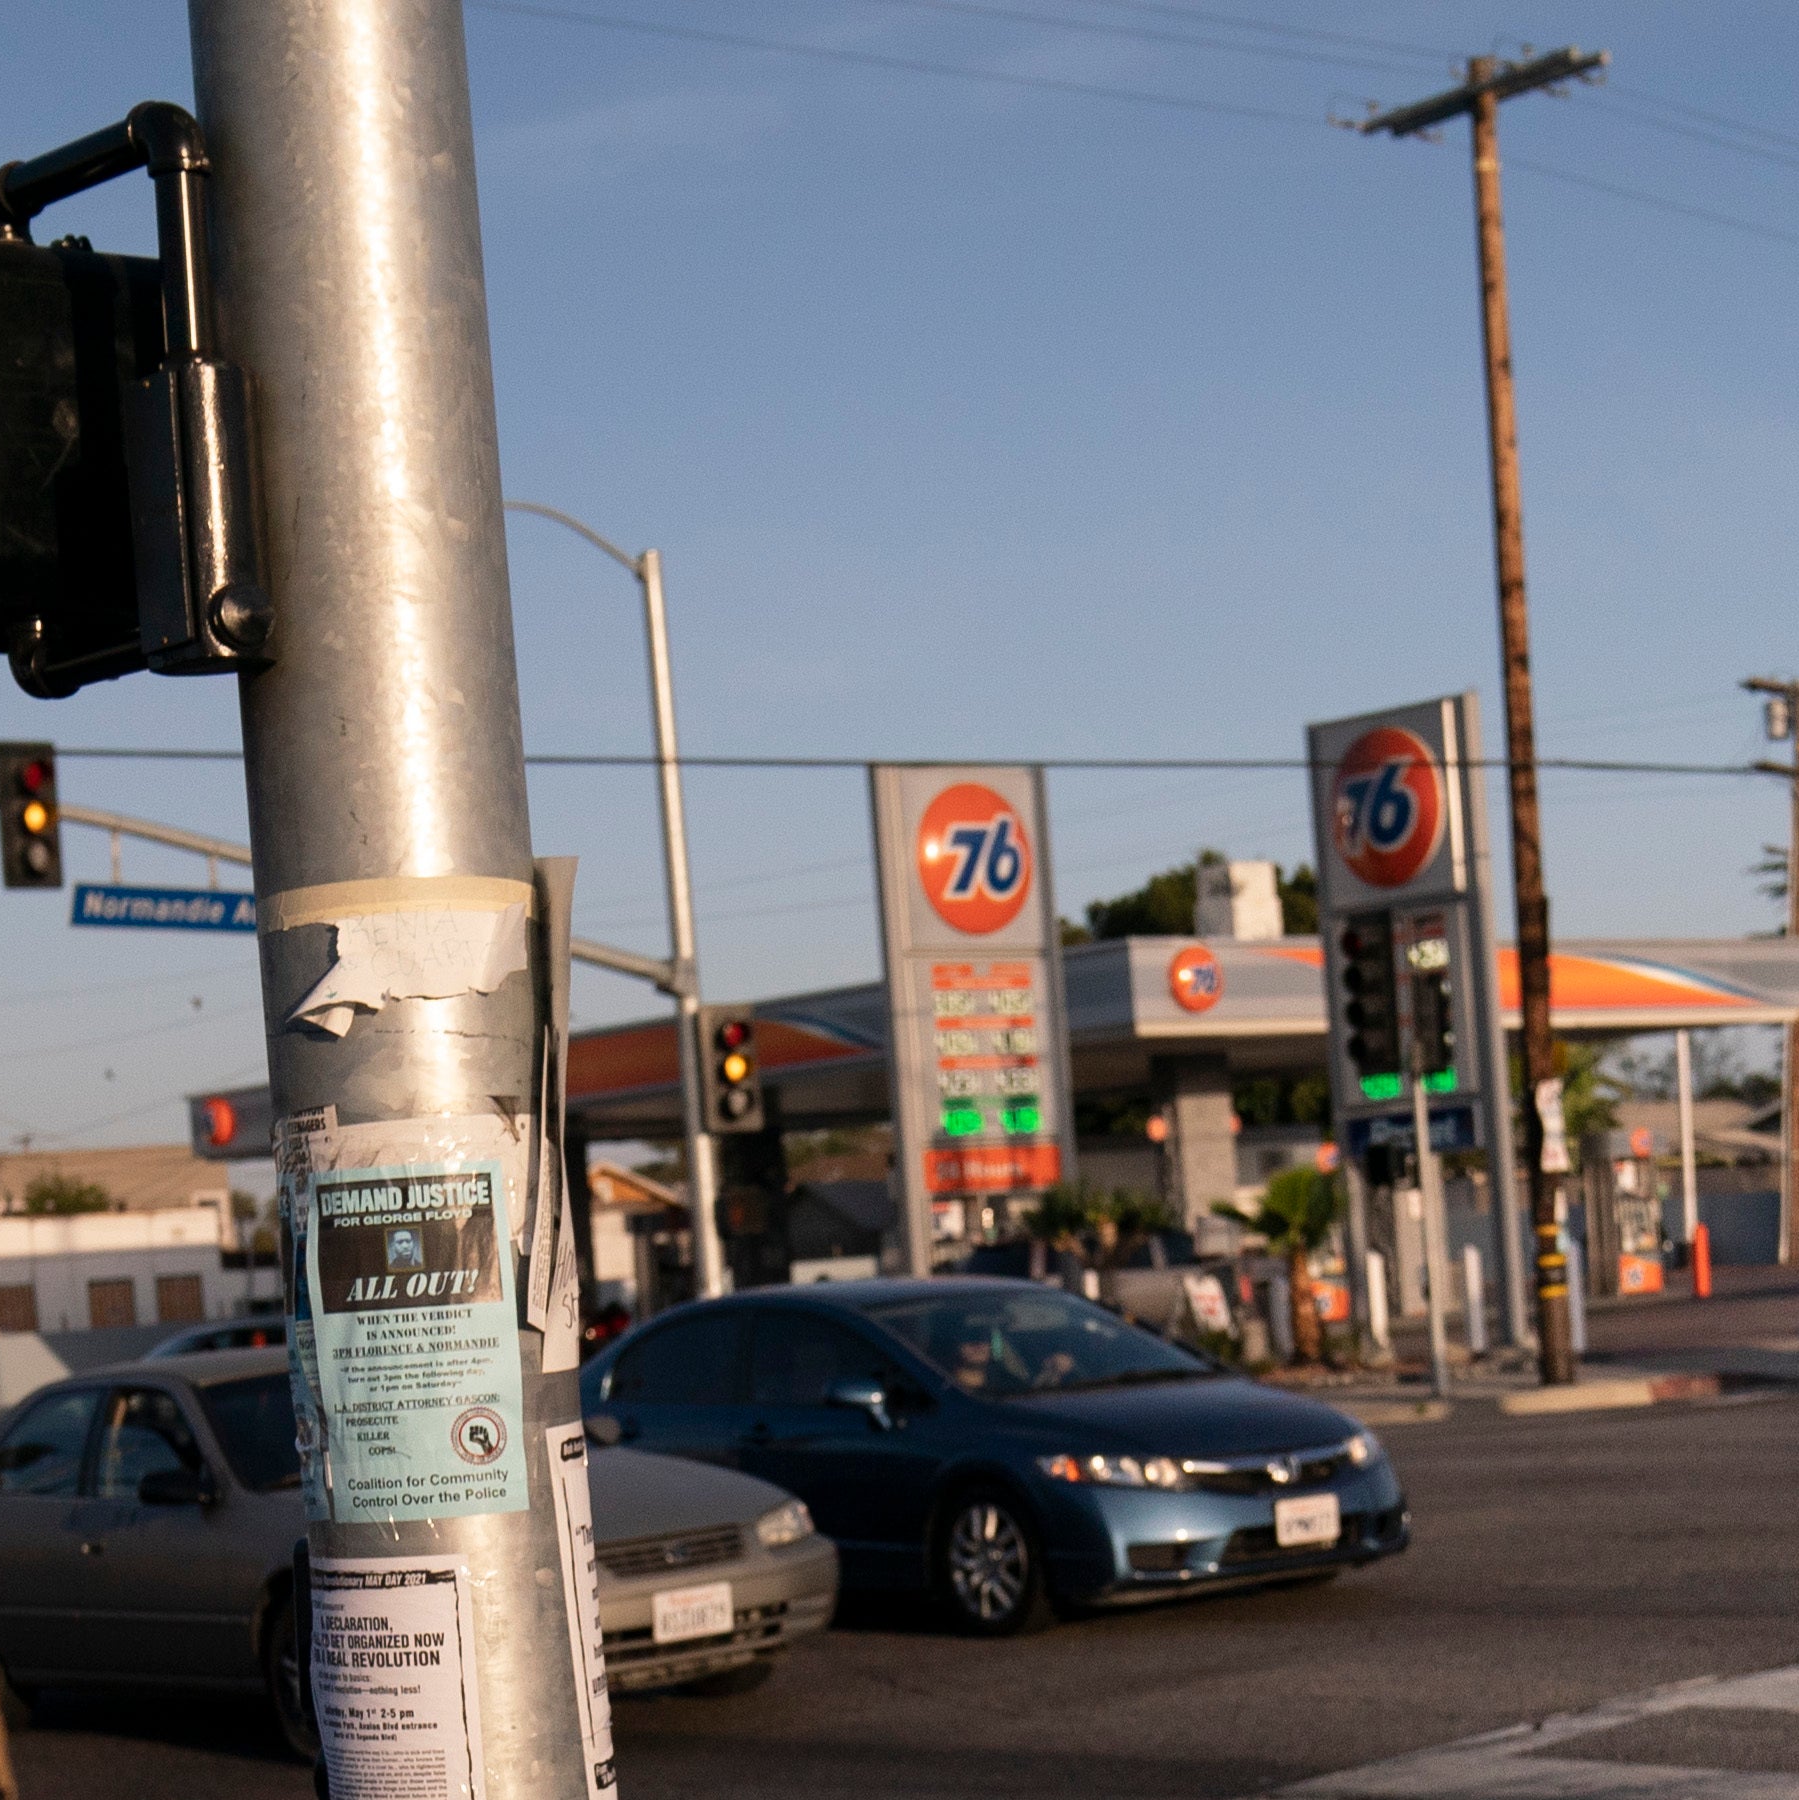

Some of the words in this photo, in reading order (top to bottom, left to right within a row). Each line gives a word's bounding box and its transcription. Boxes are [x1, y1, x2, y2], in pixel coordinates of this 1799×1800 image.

[1343, 758, 1413, 846] 76
[948, 818, 1021, 895] 76
[82, 889, 225, 923] Normandie
[320, 1186, 403, 1217] DEMAND
[406, 1181, 490, 1210] JUSTICE
[333, 1216, 360, 1228] FOR
[363, 1211, 422, 1226] GEORGE
[425, 1208, 473, 1222] FLOYD
[347, 1275, 398, 1301] ALL
[406, 1269, 480, 1298] OUT!
[357, 1315, 390, 1326] WHEN
[394, 1312, 420, 1323] THE
[422, 1309, 473, 1321] VERDICT
[366, 1331, 377, 1341] IS
[380, 1325, 456, 1339] ANNOUNCED!
[355, 1344, 413, 1357] FLORENCE
[416, 1343, 426, 1353] &
[429, 1337, 500, 1351] NORMANDIE
[352, 1401, 394, 1413] DISTRICT
[396, 1396, 452, 1410] ATTORNEY
[345, 1416, 399, 1427] PROSECUTE
[357, 1432, 390, 1443] KILLER
[348, 1475, 402, 1491] Coalition
[406, 1476, 425, 1487] for
[429, 1468, 509, 1487] Community
[352, 1492, 398, 1508] Control
[402, 1493, 435, 1506] Over
[438, 1490, 461, 1503] the
[465, 1487, 507, 1501] Police
[364, 1574, 383, 1587] MAY
[384, 1573, 402, 1586] DAY
[403, 1572, 427, 1585] 2021
[326, 1617, 393, 1632] DECLARATION,
[349, 1633, 410, 1649] ORGANIZED
[414, 1632, 445, 1647] NOW
[352, 1650, 441, 1668] REVOLUTION
[401, 1685, 421, 1694] less!
[348, 1707, 364, 1720] May
[381, 1708, 396, 1718] 2-5
[399, 1709, 414, 1720] pm
[401, 1722, 438, 1731] entrance
